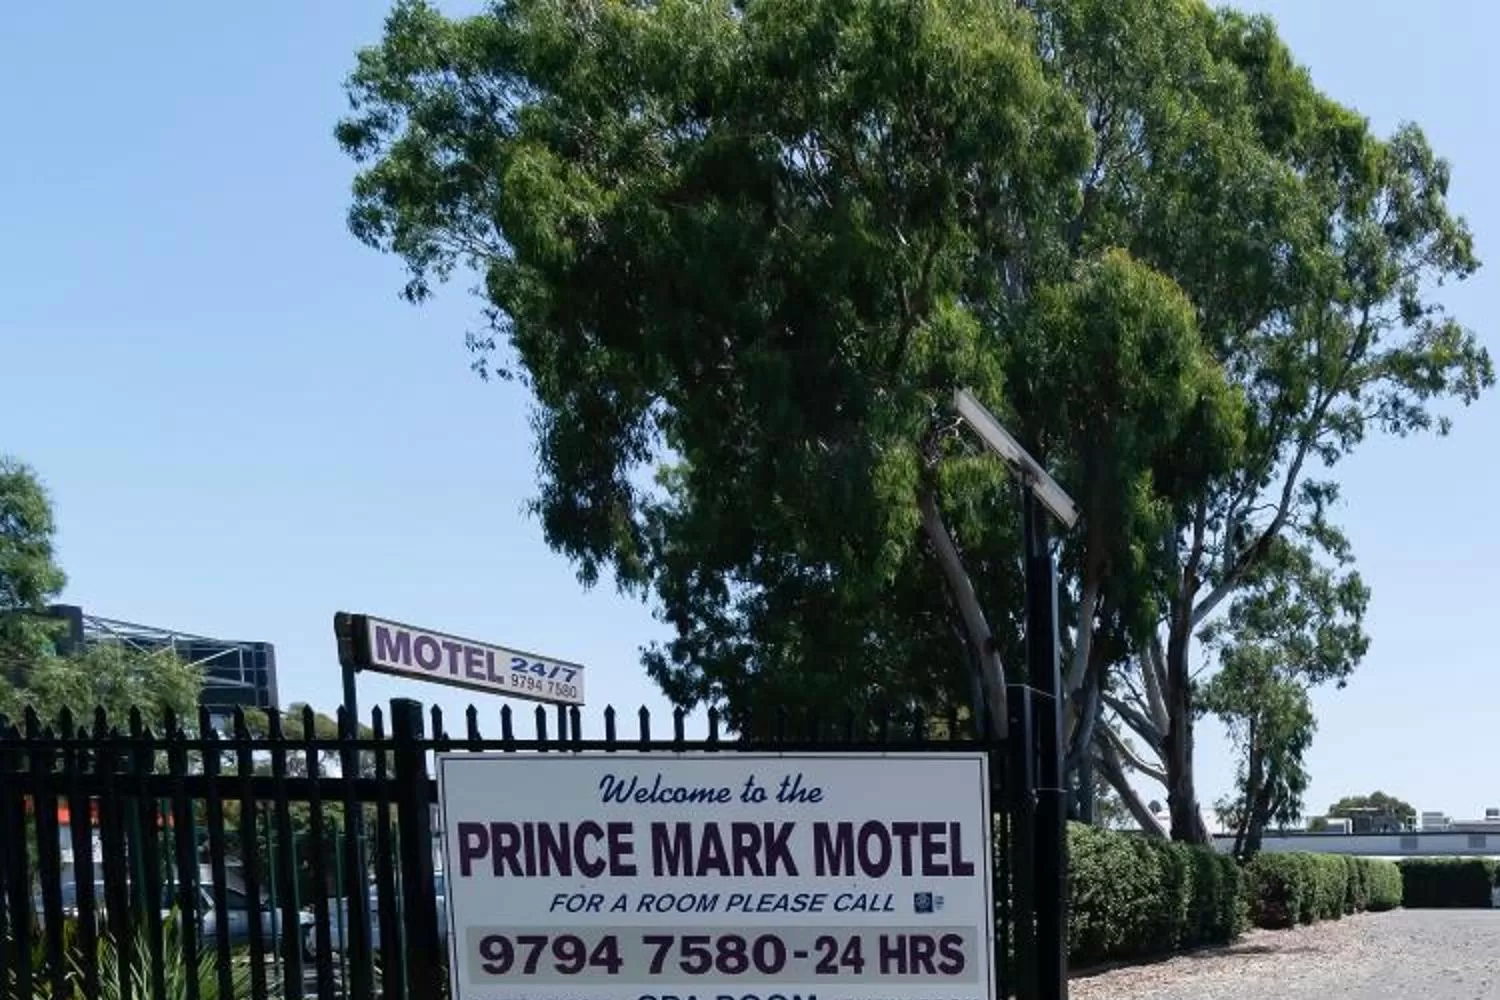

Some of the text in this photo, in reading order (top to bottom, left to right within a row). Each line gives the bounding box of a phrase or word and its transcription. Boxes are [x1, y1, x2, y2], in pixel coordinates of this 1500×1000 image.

[375, 625, 504, 684] MOTEL
[511, 657, 577, 683] 24/7
[511, 674, 577, 699] 9794 7580
[599, 773, 824, 804] Welcome to the
[457, 820, 975, 879] PRINCE MARK MOTEL
[549, 893, 896, 913] FOR A ROOM PLEASE CALL
[478, 934, 624, 976] 9794
[879, 933, 966, 976] HRS
